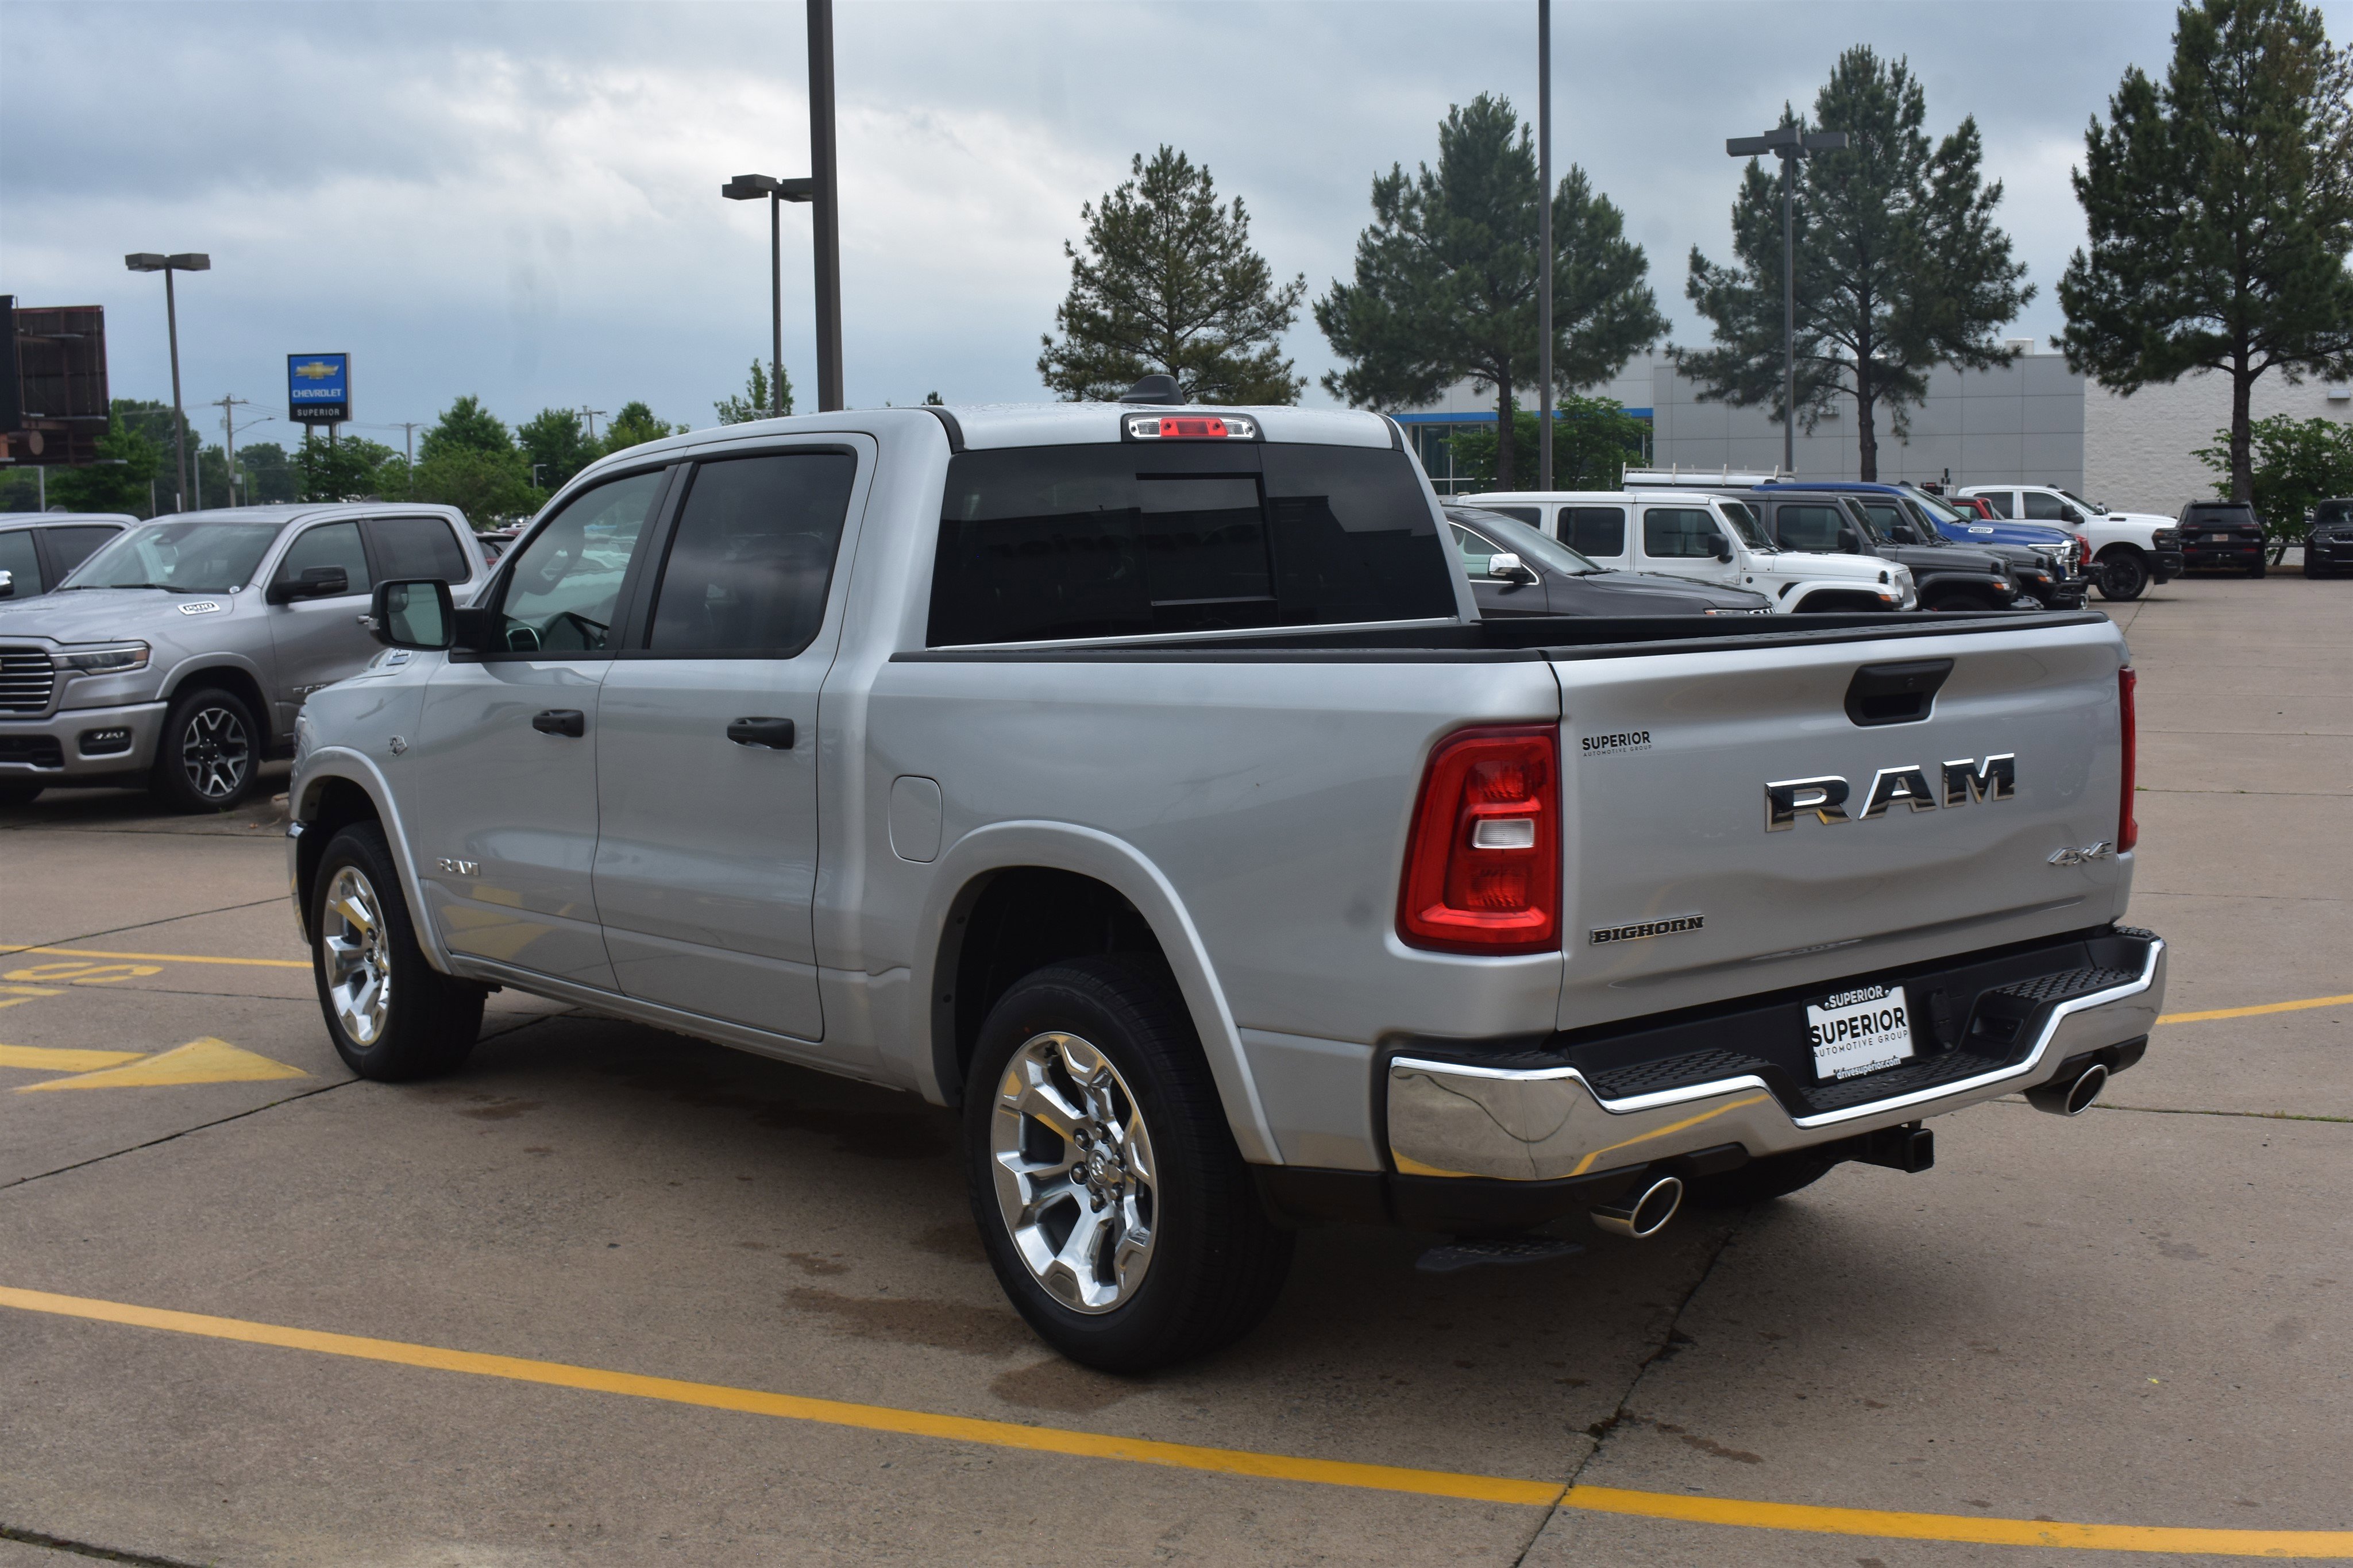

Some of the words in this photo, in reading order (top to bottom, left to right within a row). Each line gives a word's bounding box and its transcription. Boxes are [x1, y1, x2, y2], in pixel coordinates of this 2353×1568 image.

[292, 389, 342, 397] CHEVROLET
[1582, 731, 1651, 750] SUPERIOR
[1583, 748, 1626, 756] AUTOMOTIVE
[1765, 753, 2015, 832] RAM
[437, 858, 479, 876] RAM
[1829, 986, 1883, 1007] SUPERIOR
[1810, 1007, 1906, 1047] SUPERIOR
[1814, 1038, 1873, 1057] AUTOMOTIVE
[1878, 1030, 1908, 1043] GROUP
[1836, 1056, 1901, 1079] drivesuperior.com
